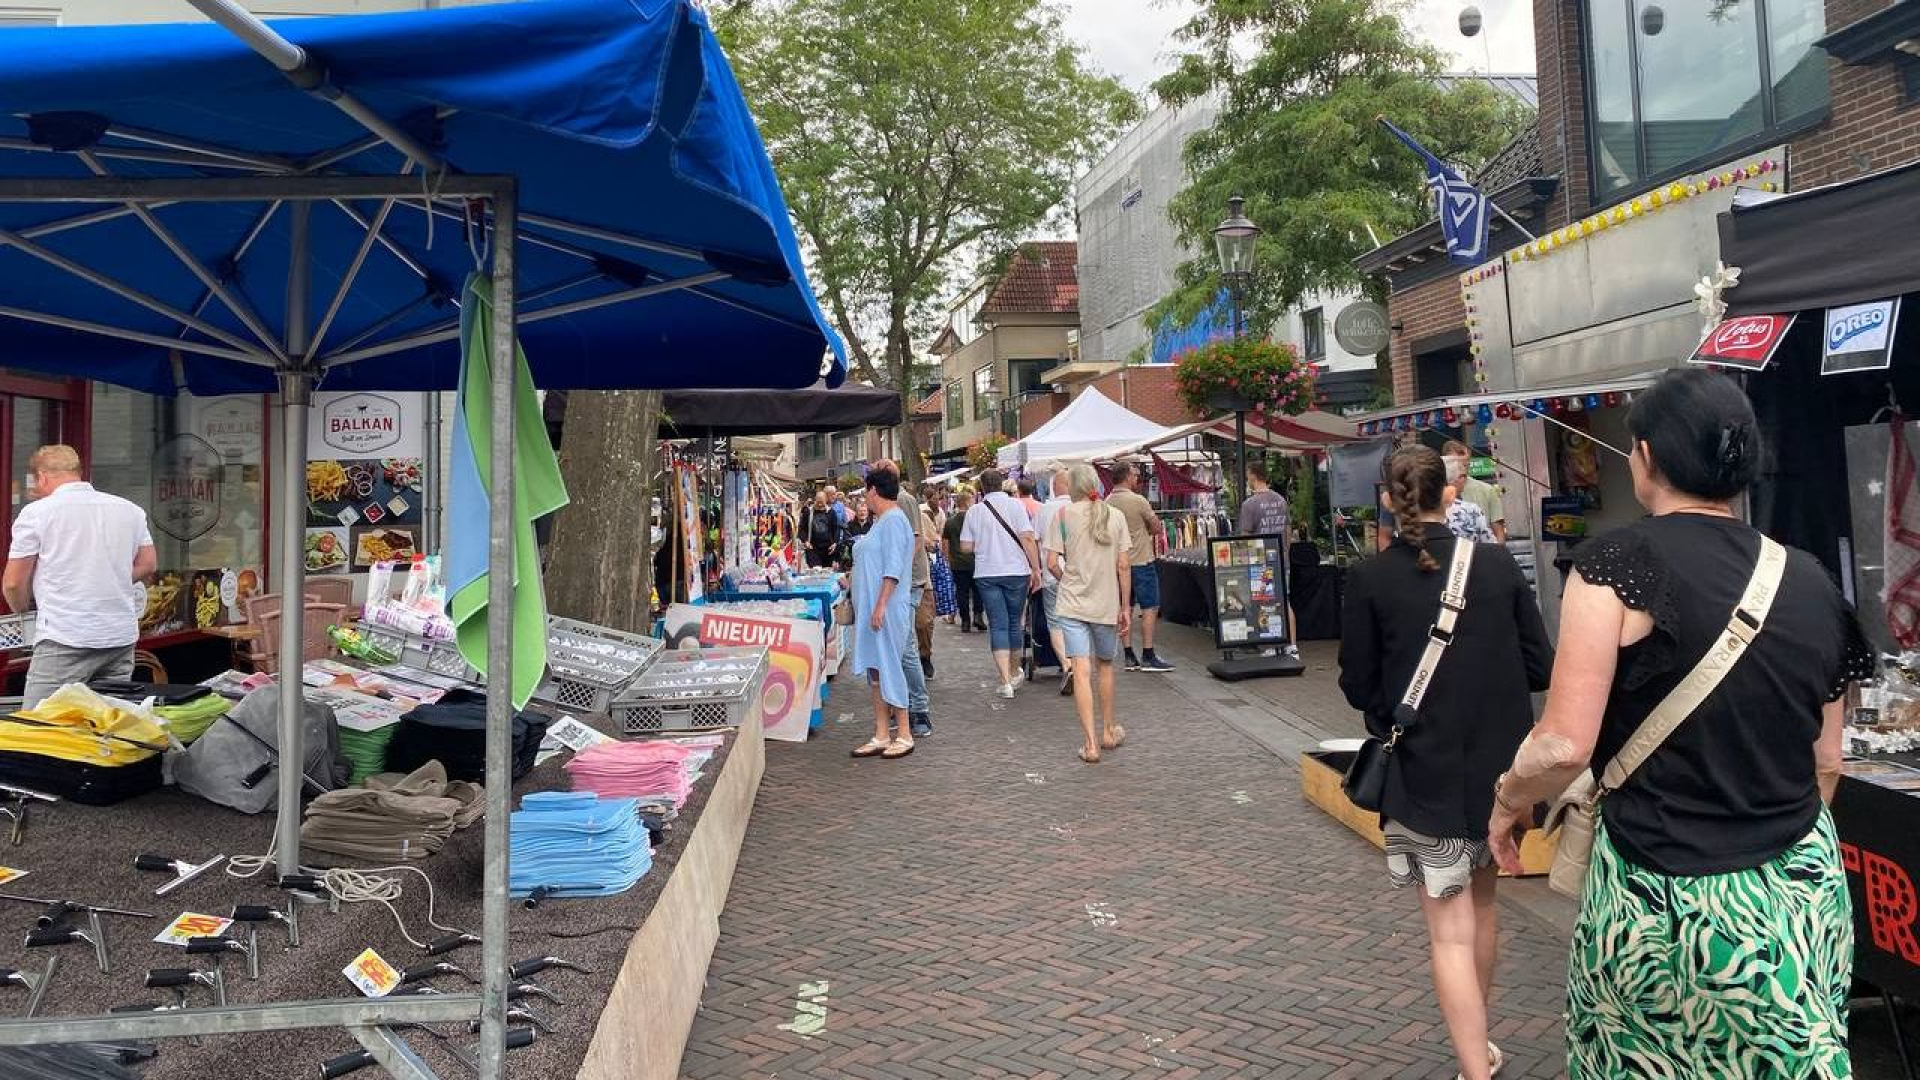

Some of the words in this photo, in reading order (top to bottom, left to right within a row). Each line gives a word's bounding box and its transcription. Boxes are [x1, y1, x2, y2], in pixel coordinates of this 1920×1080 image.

[1719, 321, 1769, 342] Lotus
[1830, 308, 1884, 345] OREO
[331, 416, 393, 433] BALKAN
[158, 477, 214, 503] BALKAN
[707, 619, 783, 647] NIEUW!
